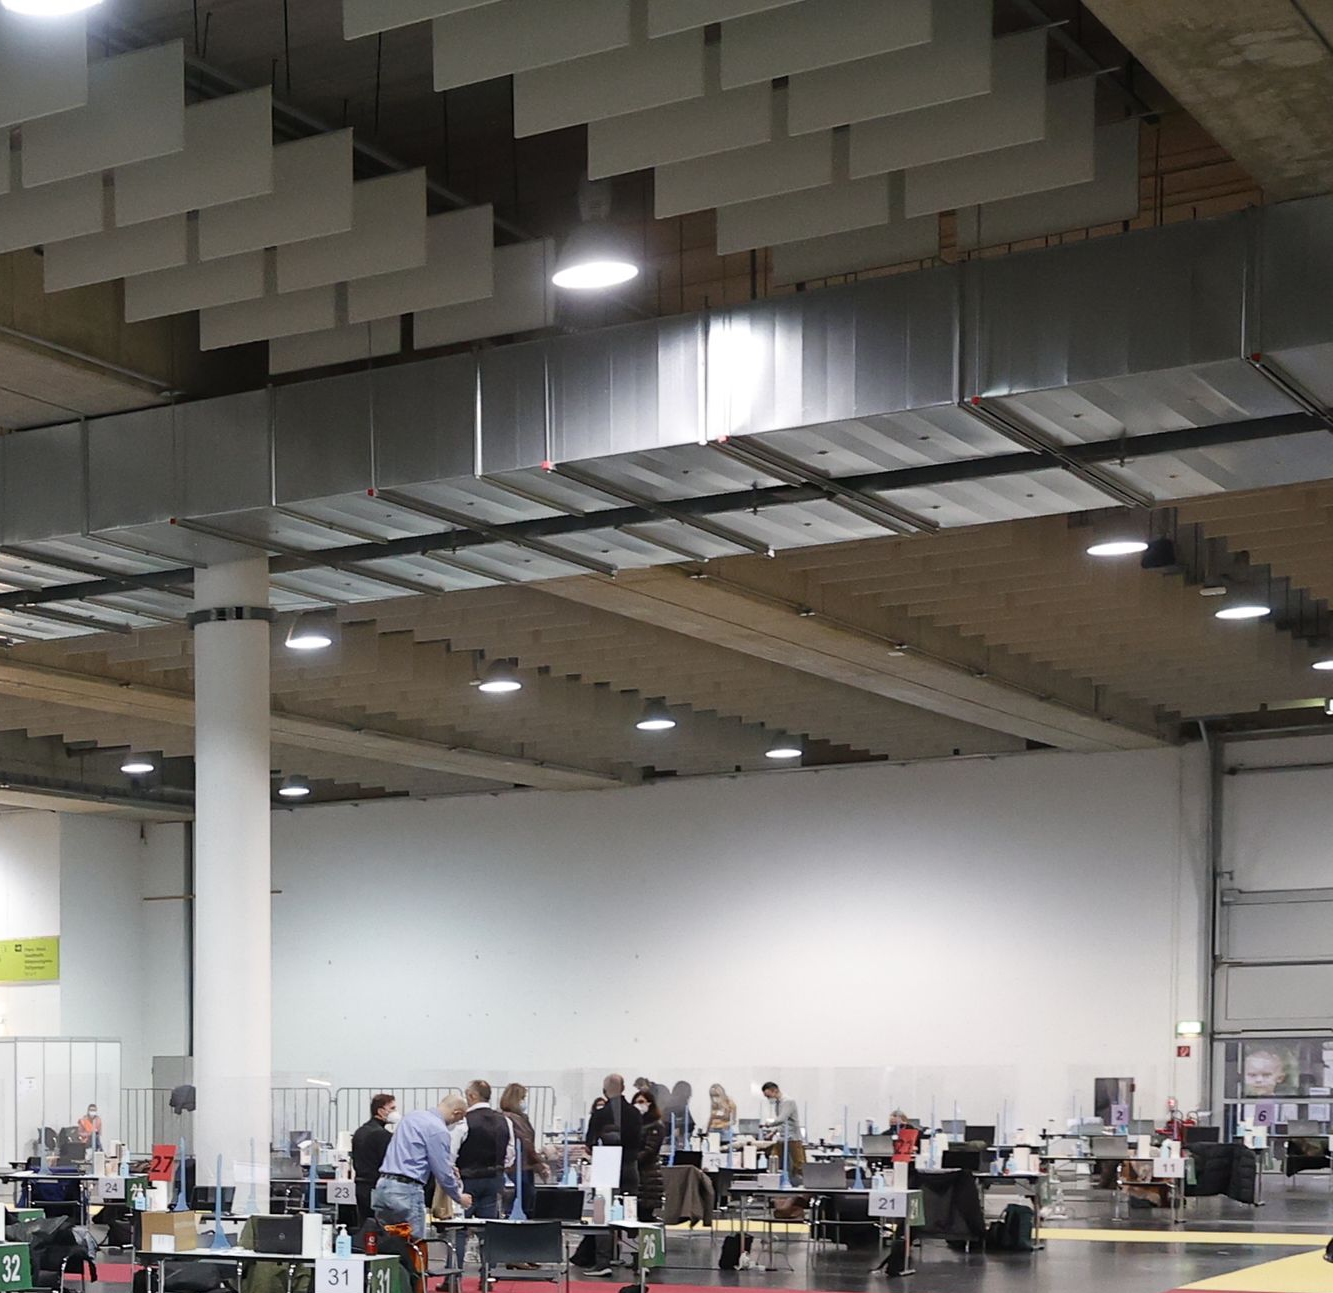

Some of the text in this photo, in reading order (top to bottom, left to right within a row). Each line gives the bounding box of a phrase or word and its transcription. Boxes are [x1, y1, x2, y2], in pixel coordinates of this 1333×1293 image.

[1115, 1110, 1124, 1121] 2
[1258, 1110, 1267, 1122] 6
[151, 1156, 174, 1173] 27
[1162, 1163, 1176, 1173] 11
[105, 1182, 118, 1194] 24
[334, 1186, 350, 1199] 23
[878, 1197, 896, 1210] 21
[642, 1233, 656, 1259] 26
[1, 1254, 21, 1283] 32
[328, 1268, 349, 1286] 31
